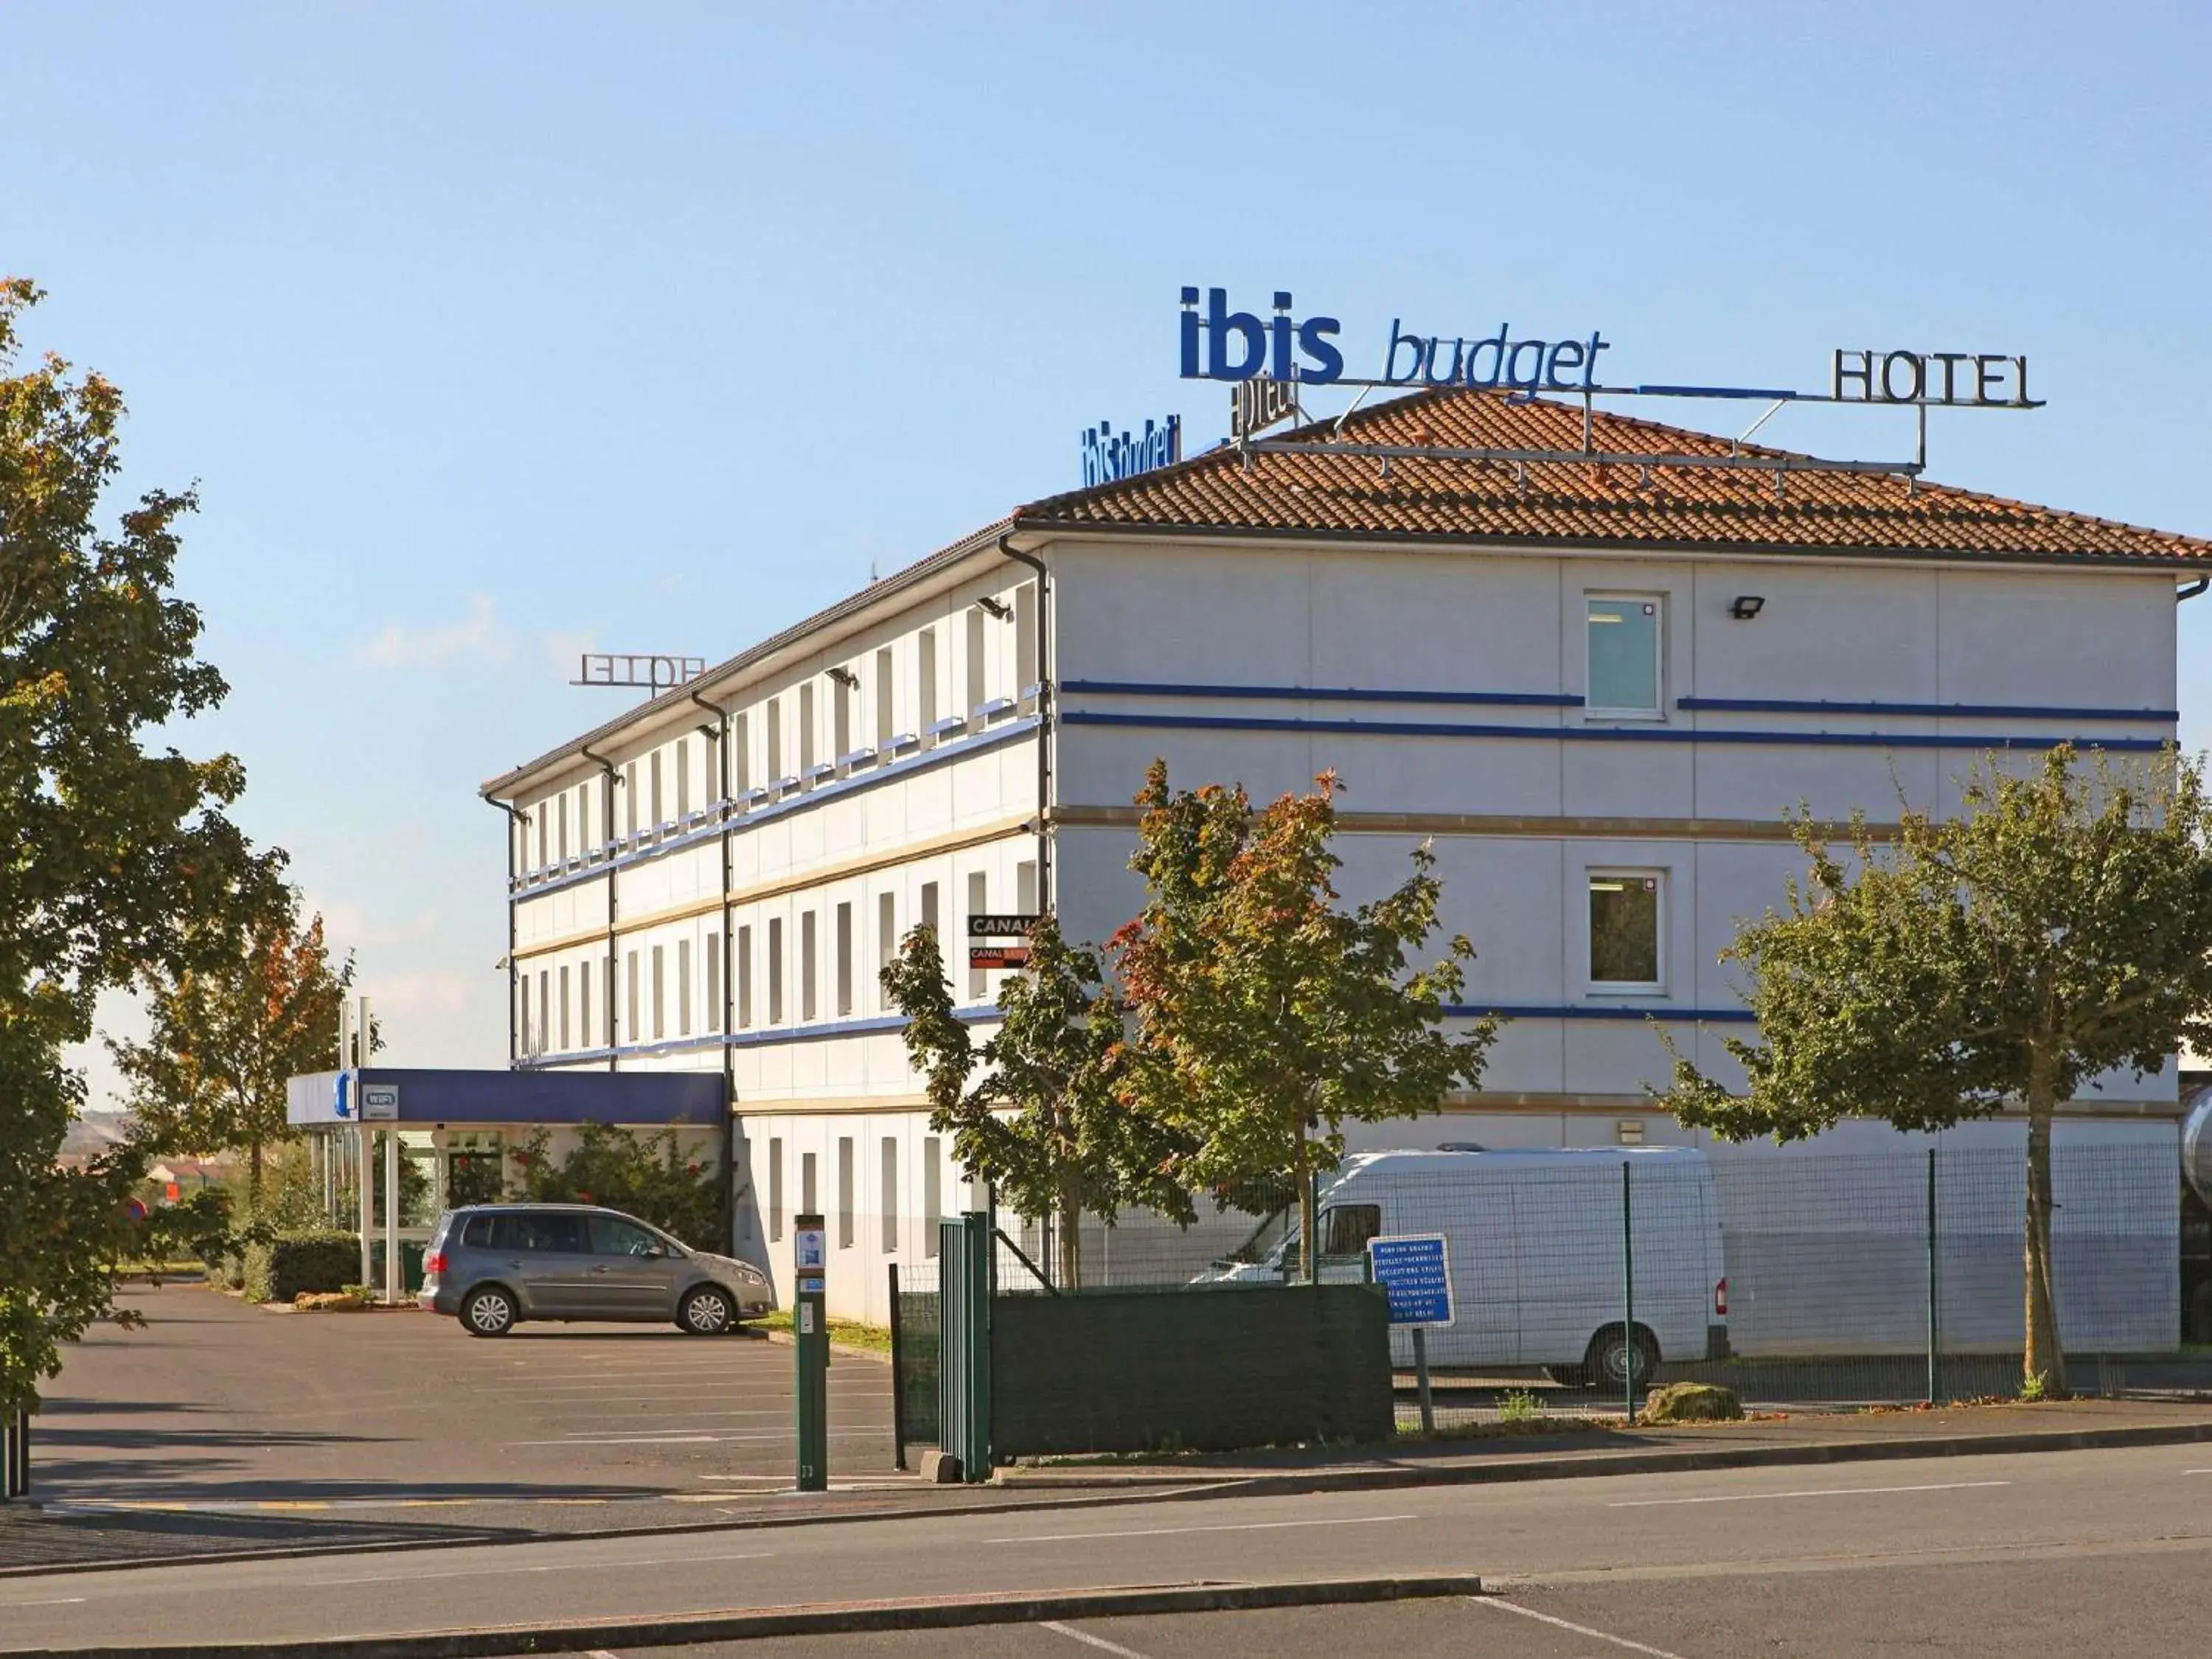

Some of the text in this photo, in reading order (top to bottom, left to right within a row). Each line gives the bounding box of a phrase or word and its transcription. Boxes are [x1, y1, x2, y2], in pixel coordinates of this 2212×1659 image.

[1180, 286, 2047, 408] ibis budget HOTEL
